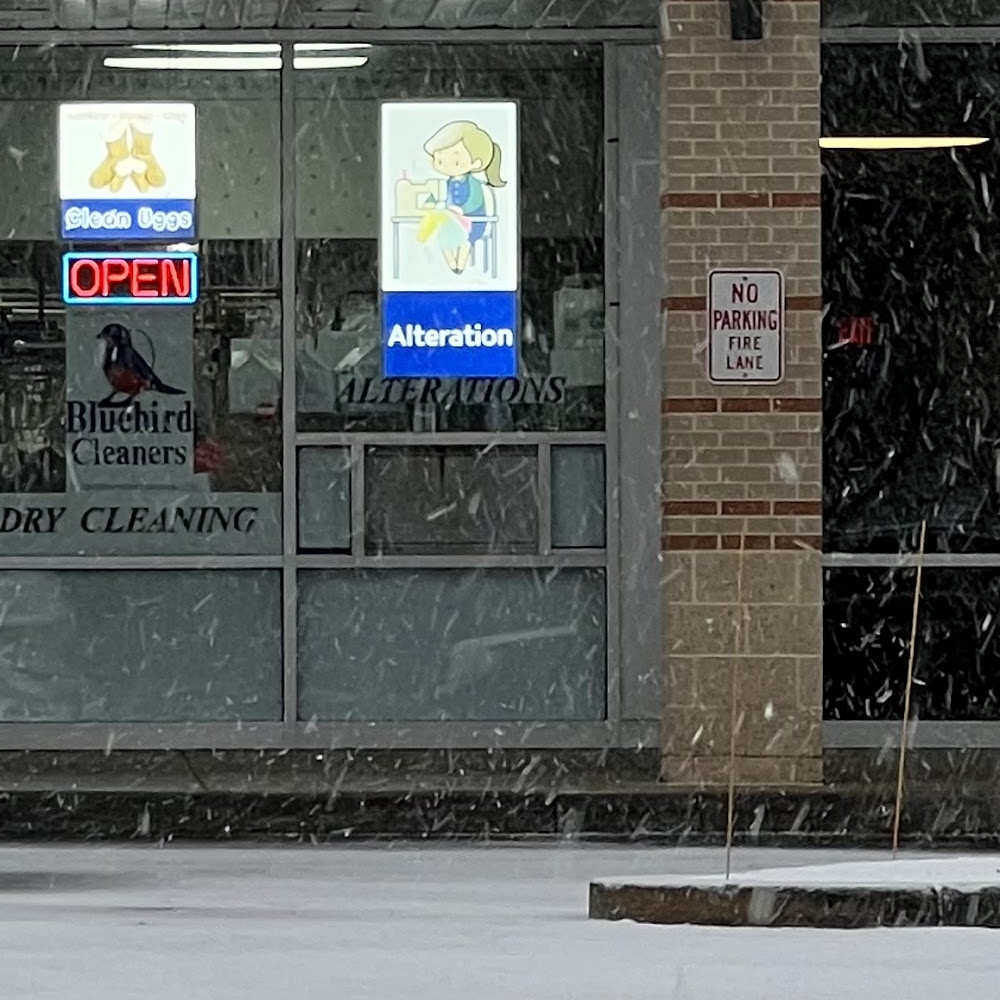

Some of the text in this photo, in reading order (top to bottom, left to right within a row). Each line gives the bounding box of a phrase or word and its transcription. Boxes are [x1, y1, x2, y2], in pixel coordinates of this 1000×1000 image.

[65, 205, 192, 232] Clean Uggs
[70, 258, 191, 297] OPEN
[731, 282, 758, 303] NO
[713, 310, 777, 331] PARKING
[387, 322, 513, 348] Alteration
[729, 336, 762, 350] FIRE
[726, 355, 763, 370] LANE
[338, 377, 567, 404] ALTERATIONS
[67, 400, 193, 433] Bluebird
[71, 438, 187, 465] Cleaners
[80, 506, 258, 535] CLEANING
